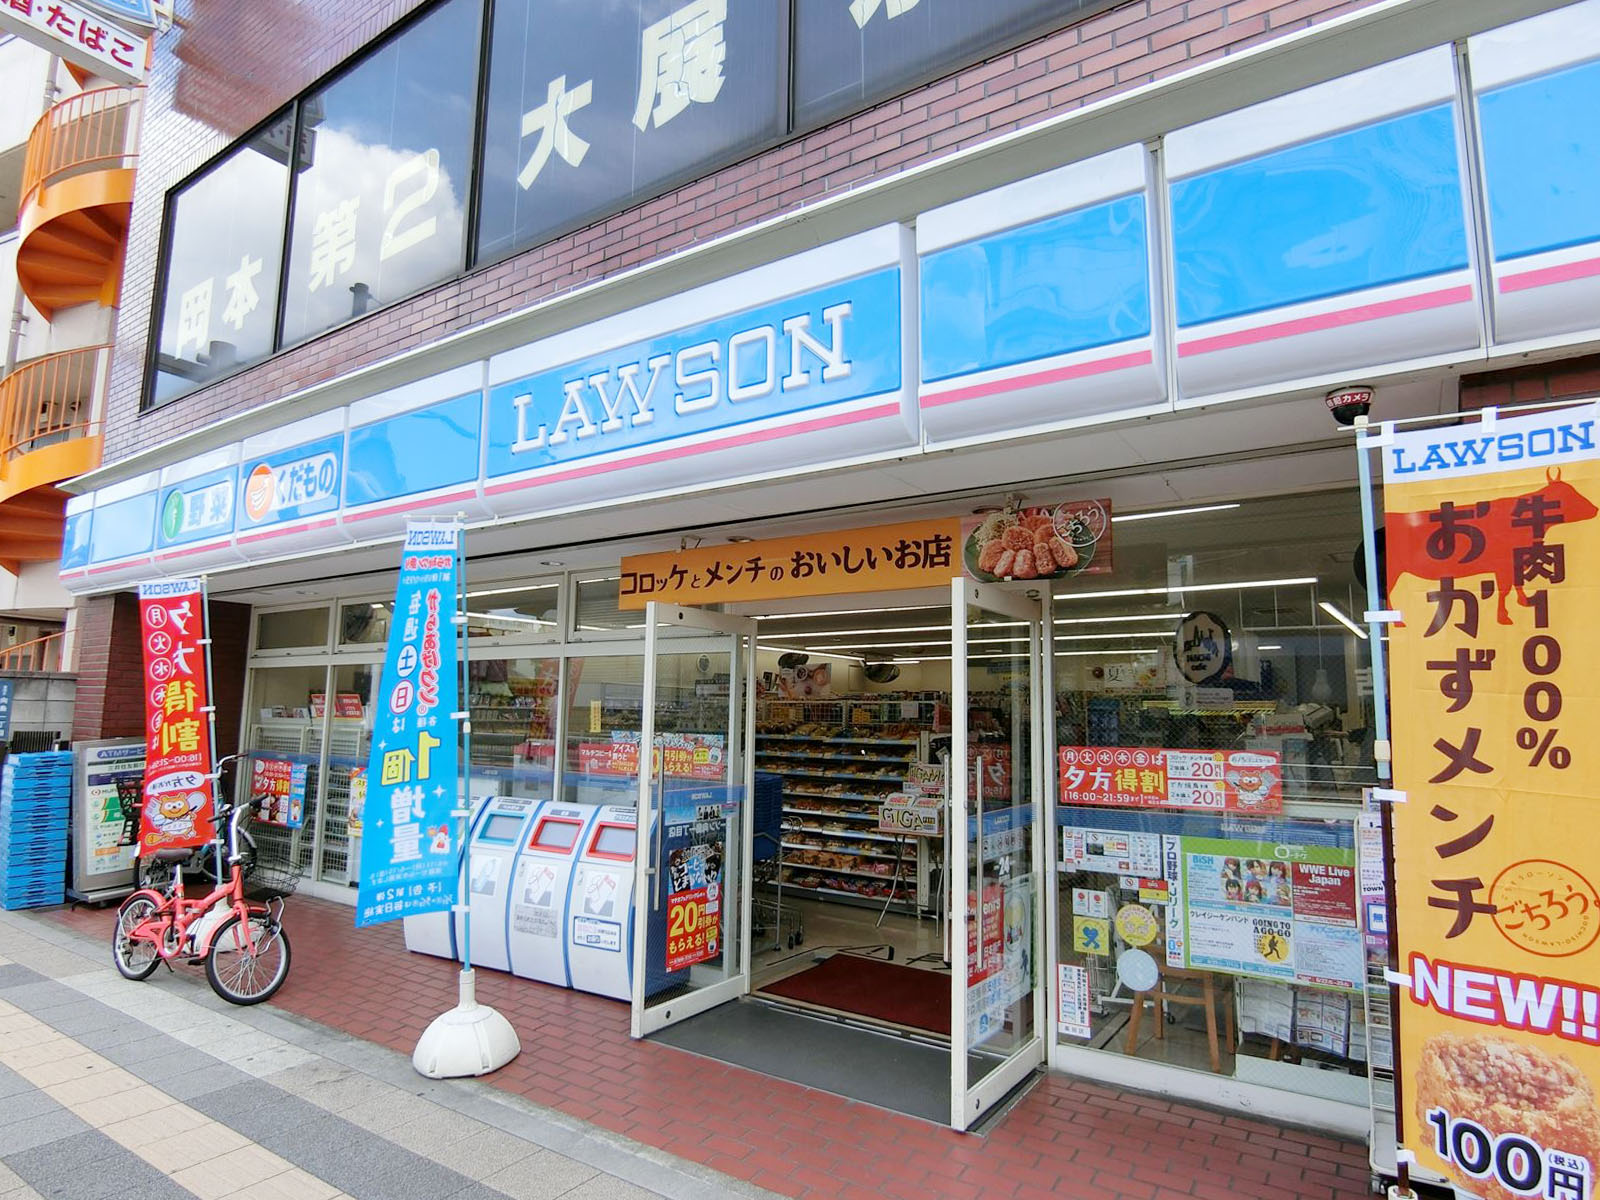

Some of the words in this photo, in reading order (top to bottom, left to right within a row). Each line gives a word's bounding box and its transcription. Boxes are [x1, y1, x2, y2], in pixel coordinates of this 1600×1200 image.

[511, 300, 853, 456] LAWSON
[1392, 420, 1596, 475] LAWSON
[277, 458, 334, 504] くだもの
[620, 534, 953, 596] コロッケとメンチのおいしいお店
[1511, 495, 1572, 770] 牛肉100%
[1424, 501, 1497, 940] おかずメンチ
[100, 747, 147, 758] ATMサービ
[1064, 767, 1165, 794] 夕方得割
[1191, 762, 1214, 777] 20
[1192, 790, 1214, 805] 20
[1192, 855, 1214, 865] BiSH
[1299, 864, 1326, 875] WWE
[1328, 866, 1350, 878] Live
[1309, 874, 1342, 886] Japan
[1253, 918, 1279, 930] GOING
[1280, 921, 1291, 930] TO
[669, 932, 705, 955] もらえる!
[1414, 957, 1598, 1040] NEW!!
